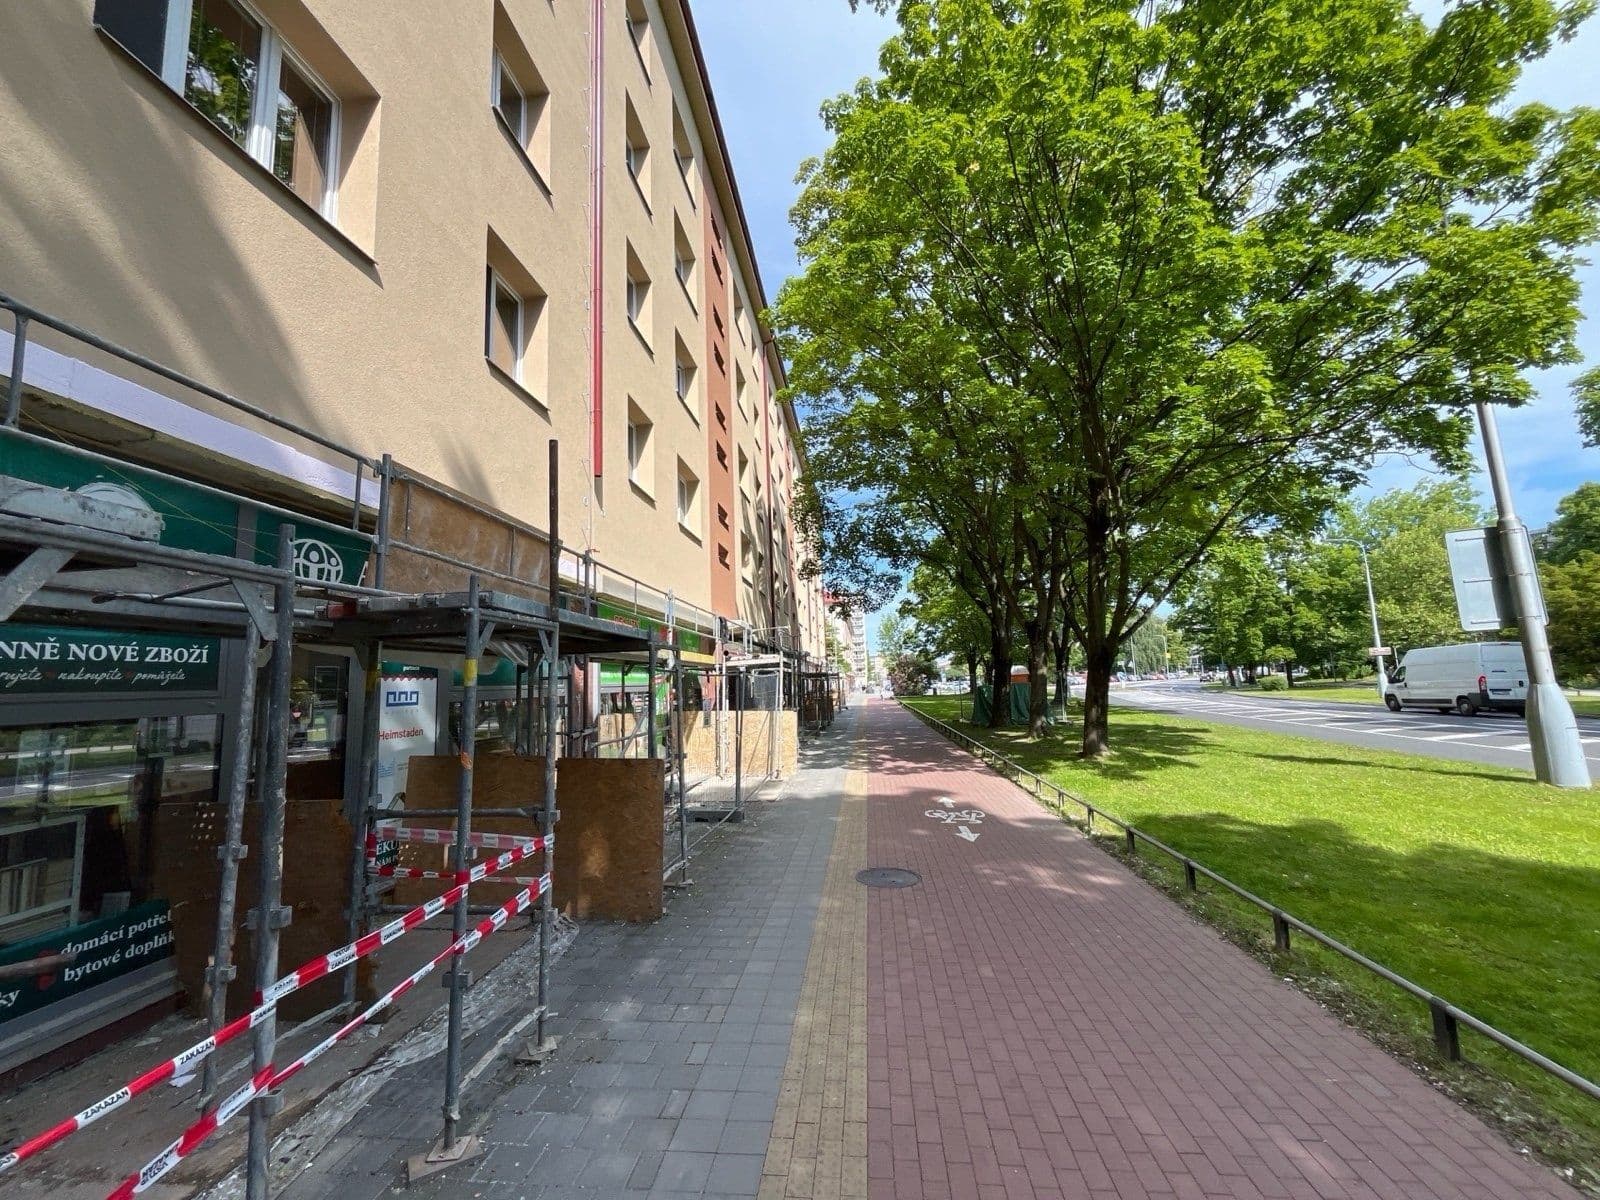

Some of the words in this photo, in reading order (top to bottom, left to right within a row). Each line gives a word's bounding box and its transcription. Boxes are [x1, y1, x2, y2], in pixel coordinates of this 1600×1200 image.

[0, 636, 60, 660] NNĚ
[67, 641, 140, 662] NOVÉ
[144, 644, 209, 664] ZBOŽÍ
[377, 727, 424, 740] Heimstaden
[61, 925, 125, 955] domácí
[64, 949, 121, 982] bytové
